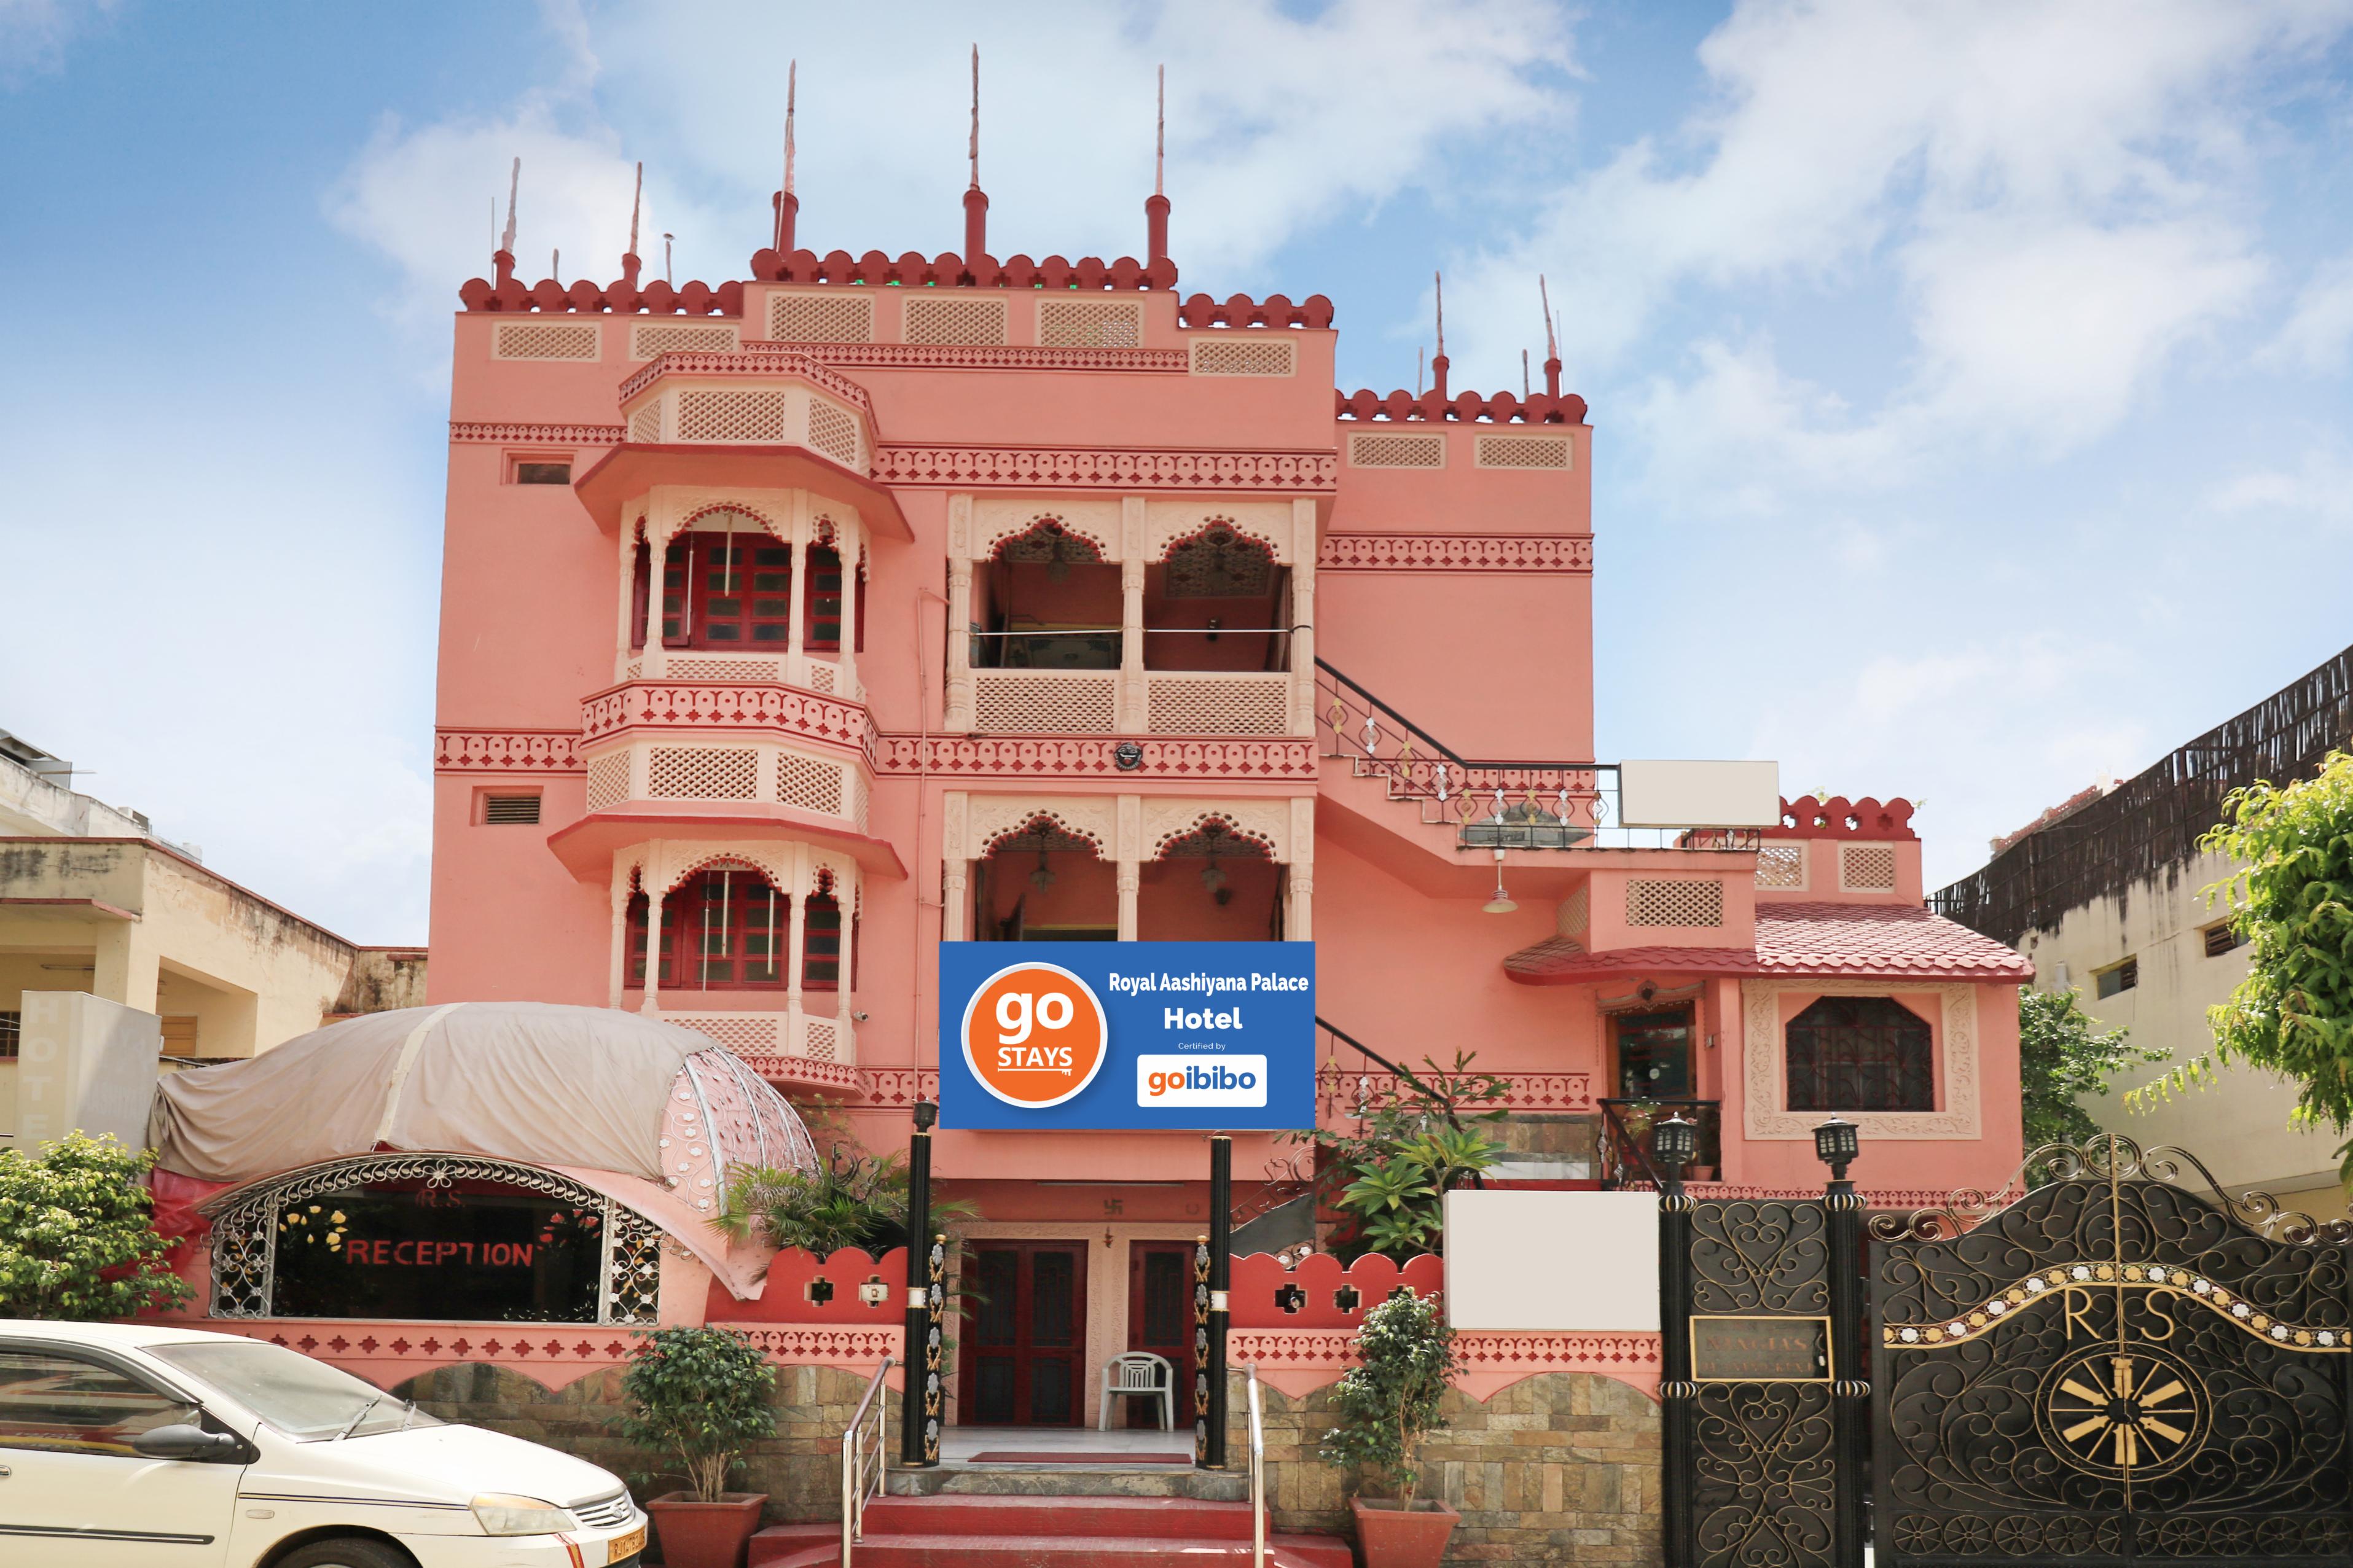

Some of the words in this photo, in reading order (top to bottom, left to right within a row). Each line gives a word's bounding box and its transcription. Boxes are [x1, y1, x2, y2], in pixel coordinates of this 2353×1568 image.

[1109, 972, 1156, 996] Royal
[1159, 972, 1247, 996] Aashiyana
[1251, 972, 1309, 991] Palace
[995, 989, 1075, 1045] go
[1164, 1007, 1243, 1029] Hotel
[998, 1047, 1073, 1067] STAYS
[1178, 1042, 1213, 1050] Certified
[1216, 1042, 1226, 1052] by
[22, 998, 60, 1140] HOTE
[1148, 1066, 1256, 1096] goibibo
[346, 1239, 533, 1266] RECEPTION
